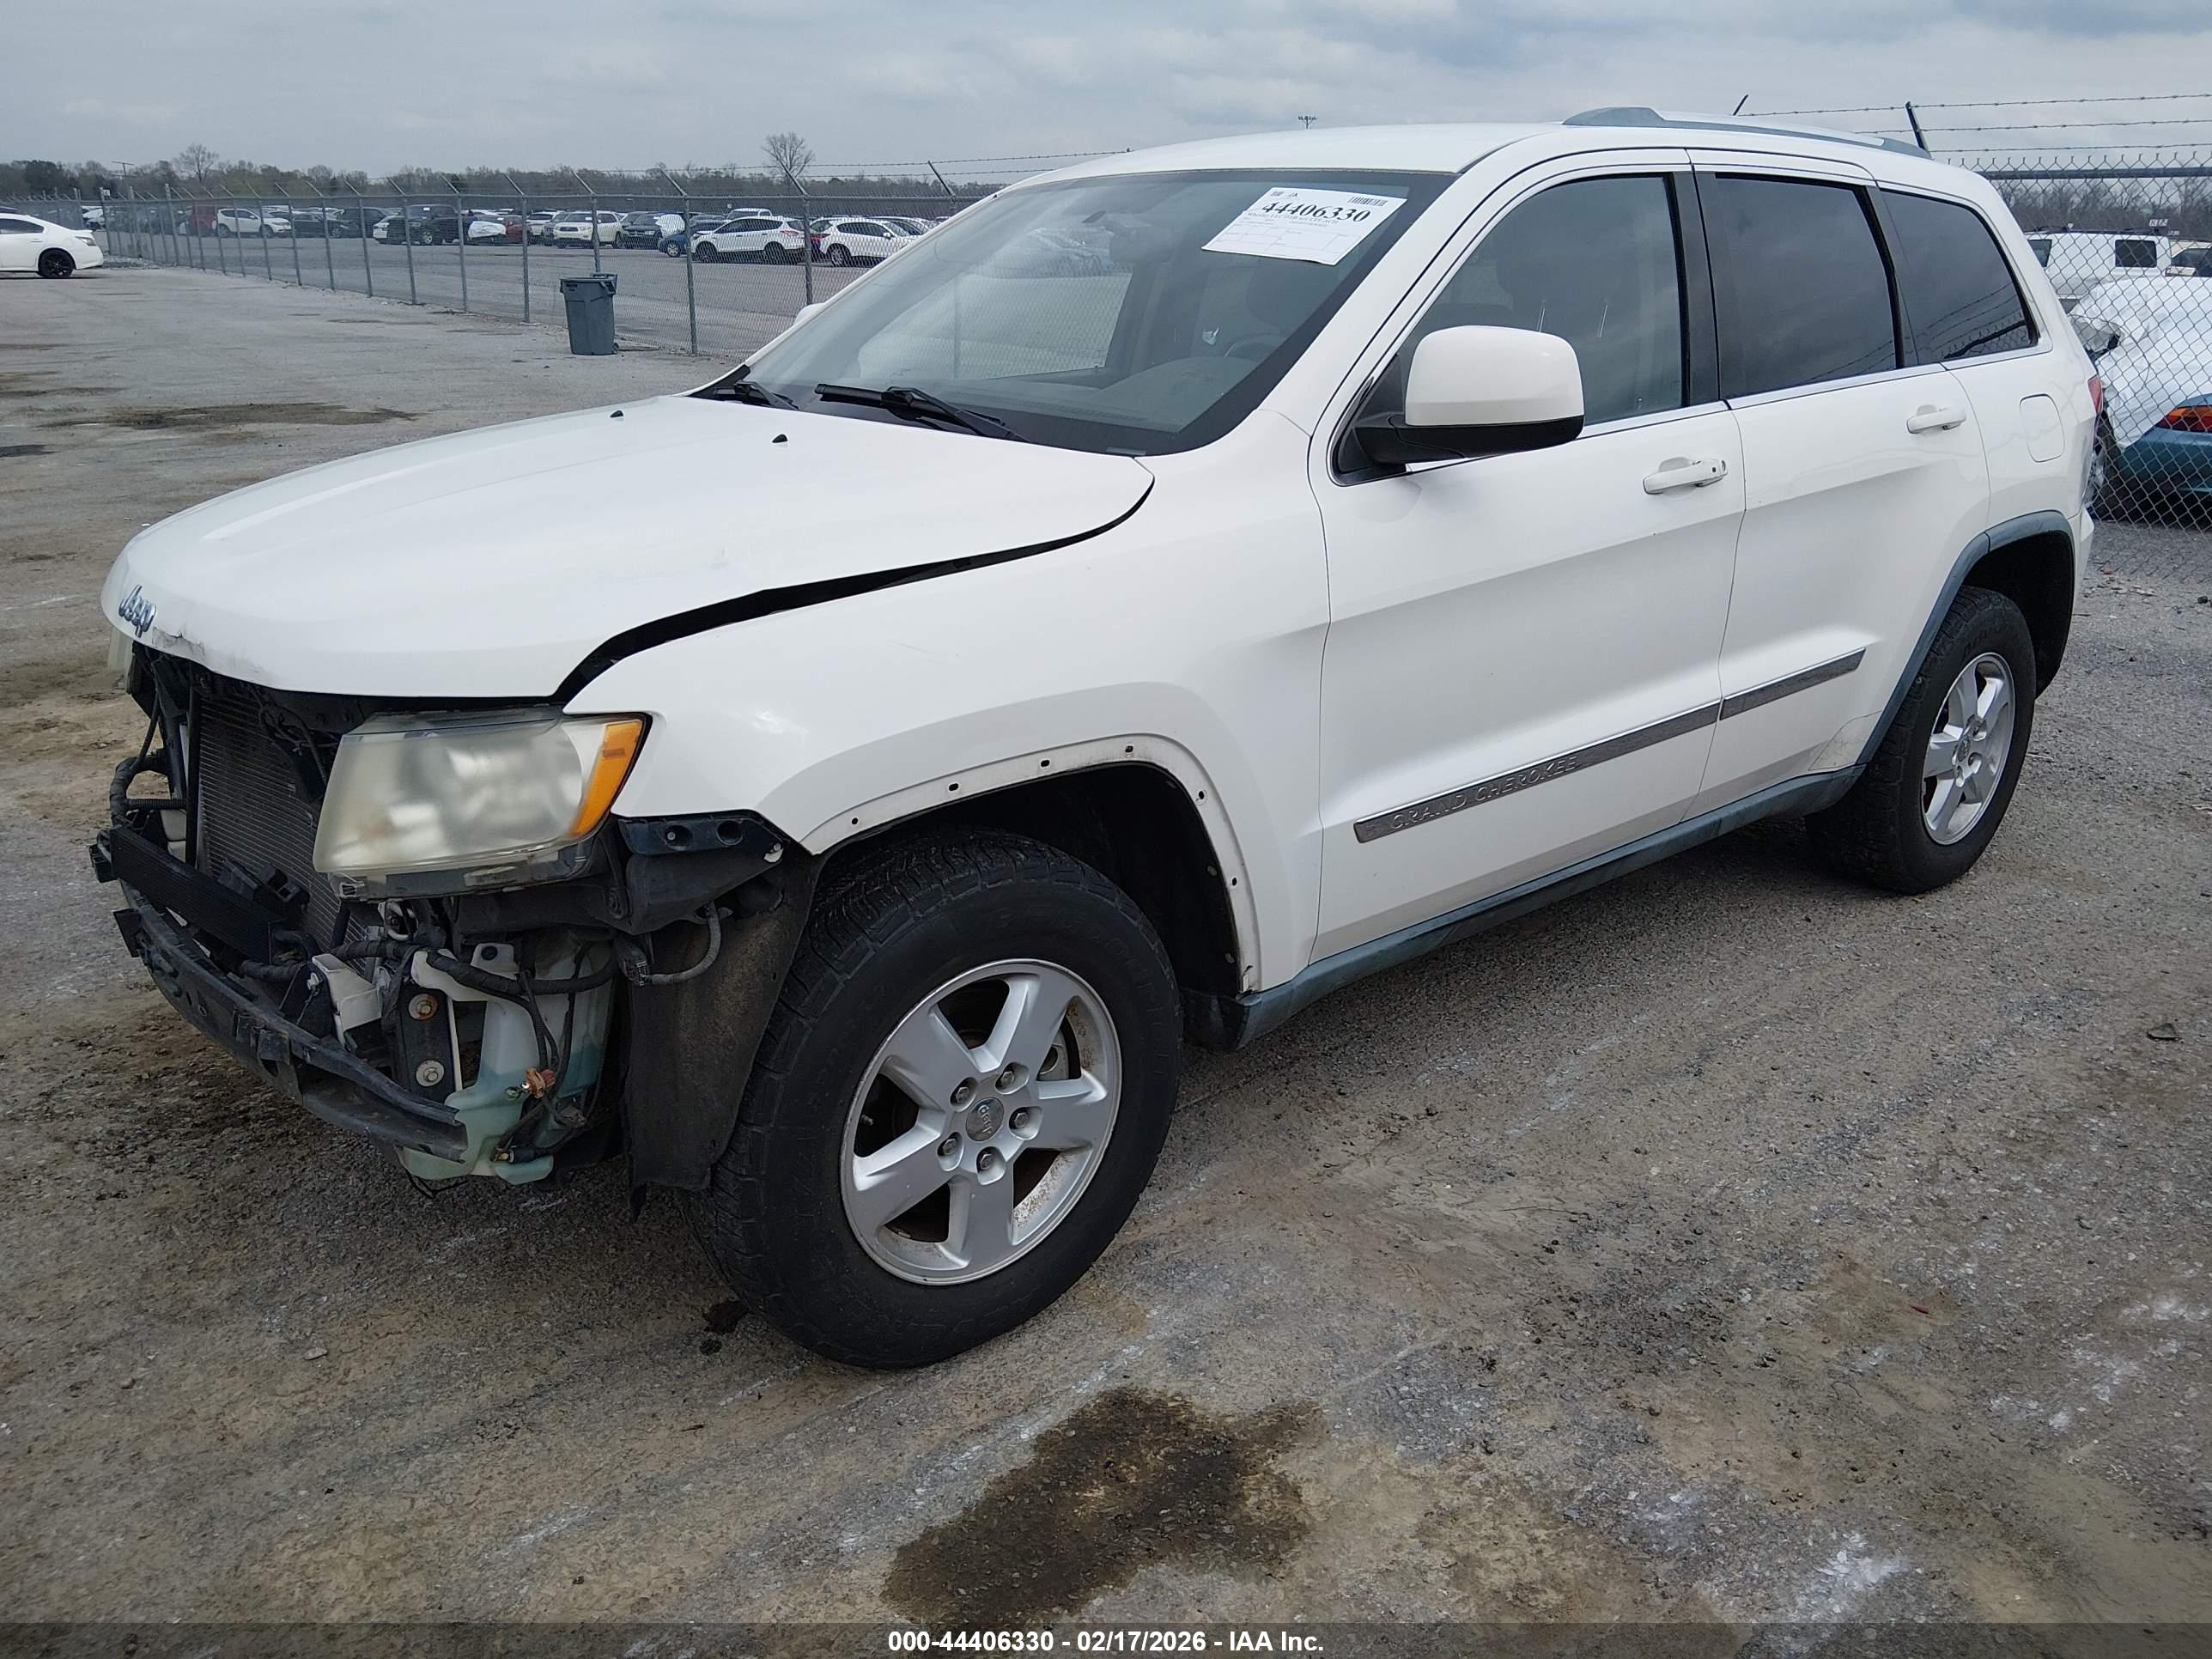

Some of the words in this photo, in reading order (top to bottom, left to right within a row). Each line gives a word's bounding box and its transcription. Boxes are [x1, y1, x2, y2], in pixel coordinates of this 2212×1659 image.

[1262, 201, 1371, 222] 44406330
[118, 584, 156, 638] Jeep
[1391, 793, 1468, 830] GRAND
[1475, 756, 1578, 802] CHEROKEE
[977, 1104, 992, 1134] Jeep
